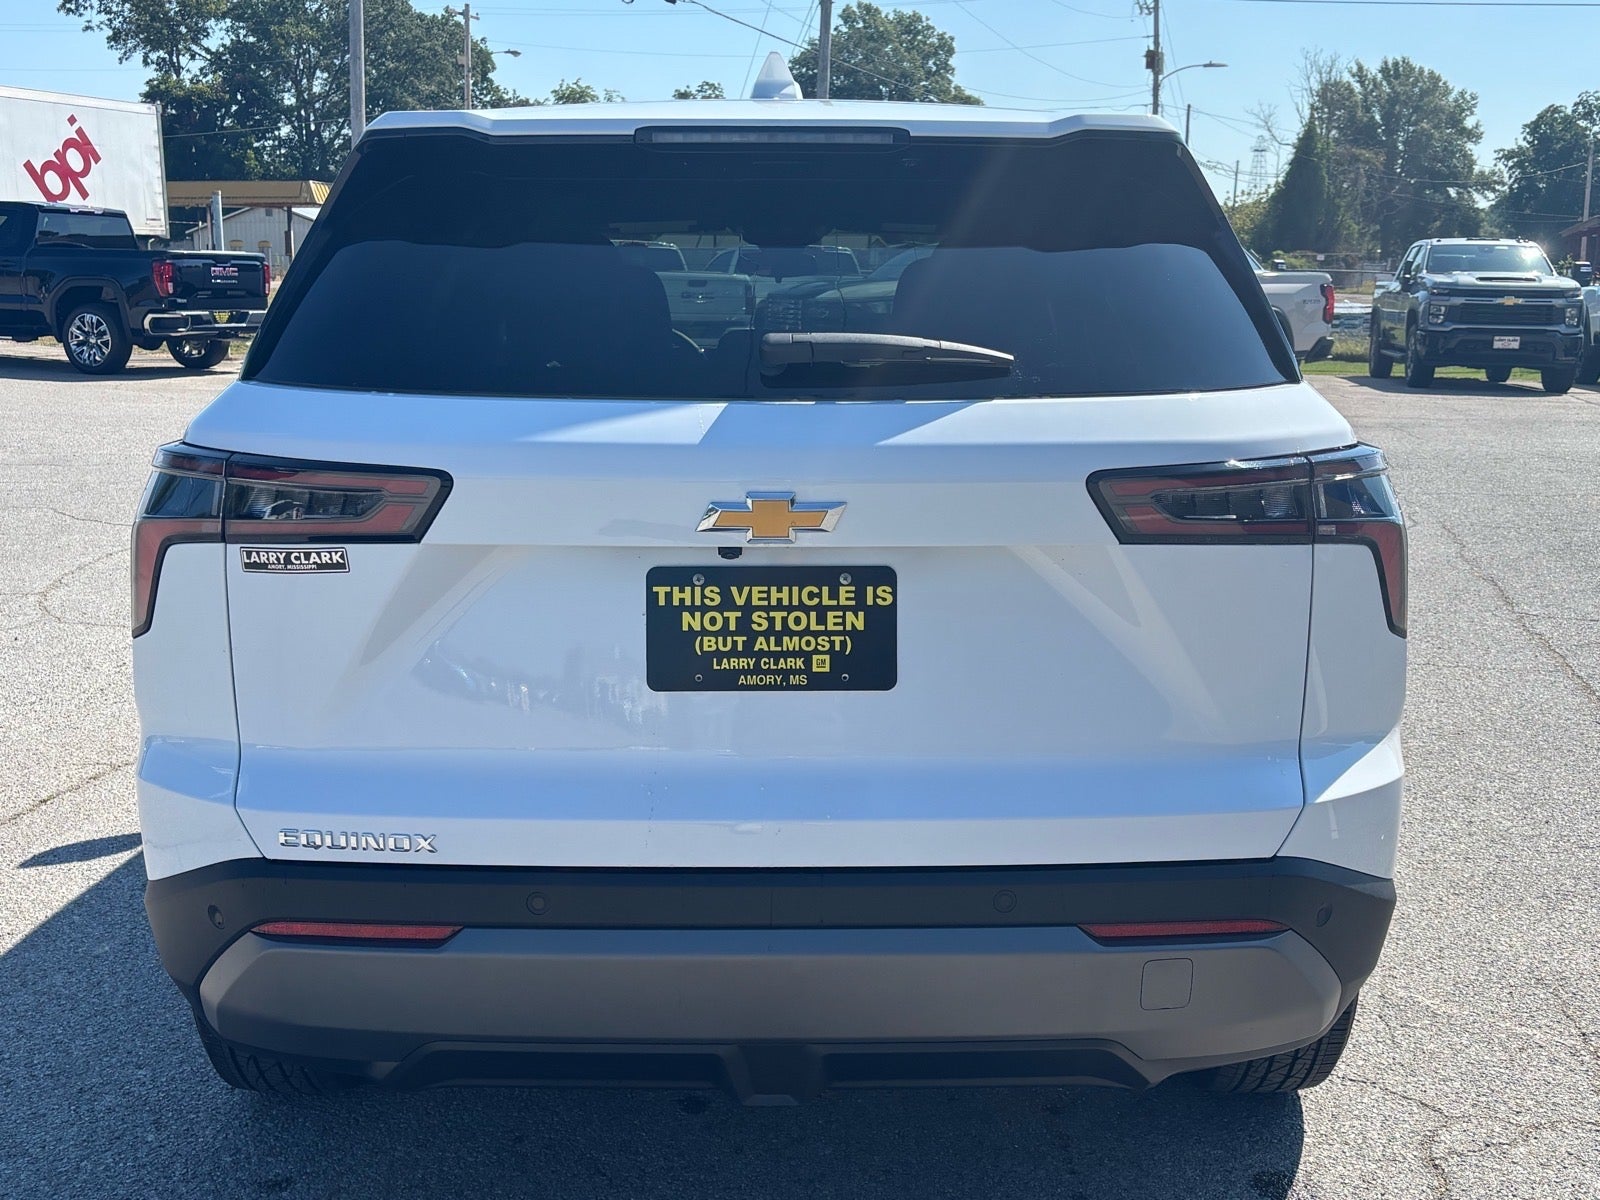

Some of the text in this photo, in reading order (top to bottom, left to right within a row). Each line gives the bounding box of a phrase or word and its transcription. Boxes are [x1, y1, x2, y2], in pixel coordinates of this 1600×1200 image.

[23, 113, 102, 203] bpi
[210, 266, 239, 277] GMC
[242, 551, 345, 564] LARRY CLARK
[652, 585, 894, 606] THIS VEHICLE IS
[681, 611, 865, 631] NOT STOLEN
[694, 636, 852, 655] (BUT ALMOST)
[713, 657, 756, 670] LARRY
[760, 657, 806, 670] CLARK
[738, 674, 808, 687] AMORY, MS
[278, 828, 438, 853] EQUINOX
